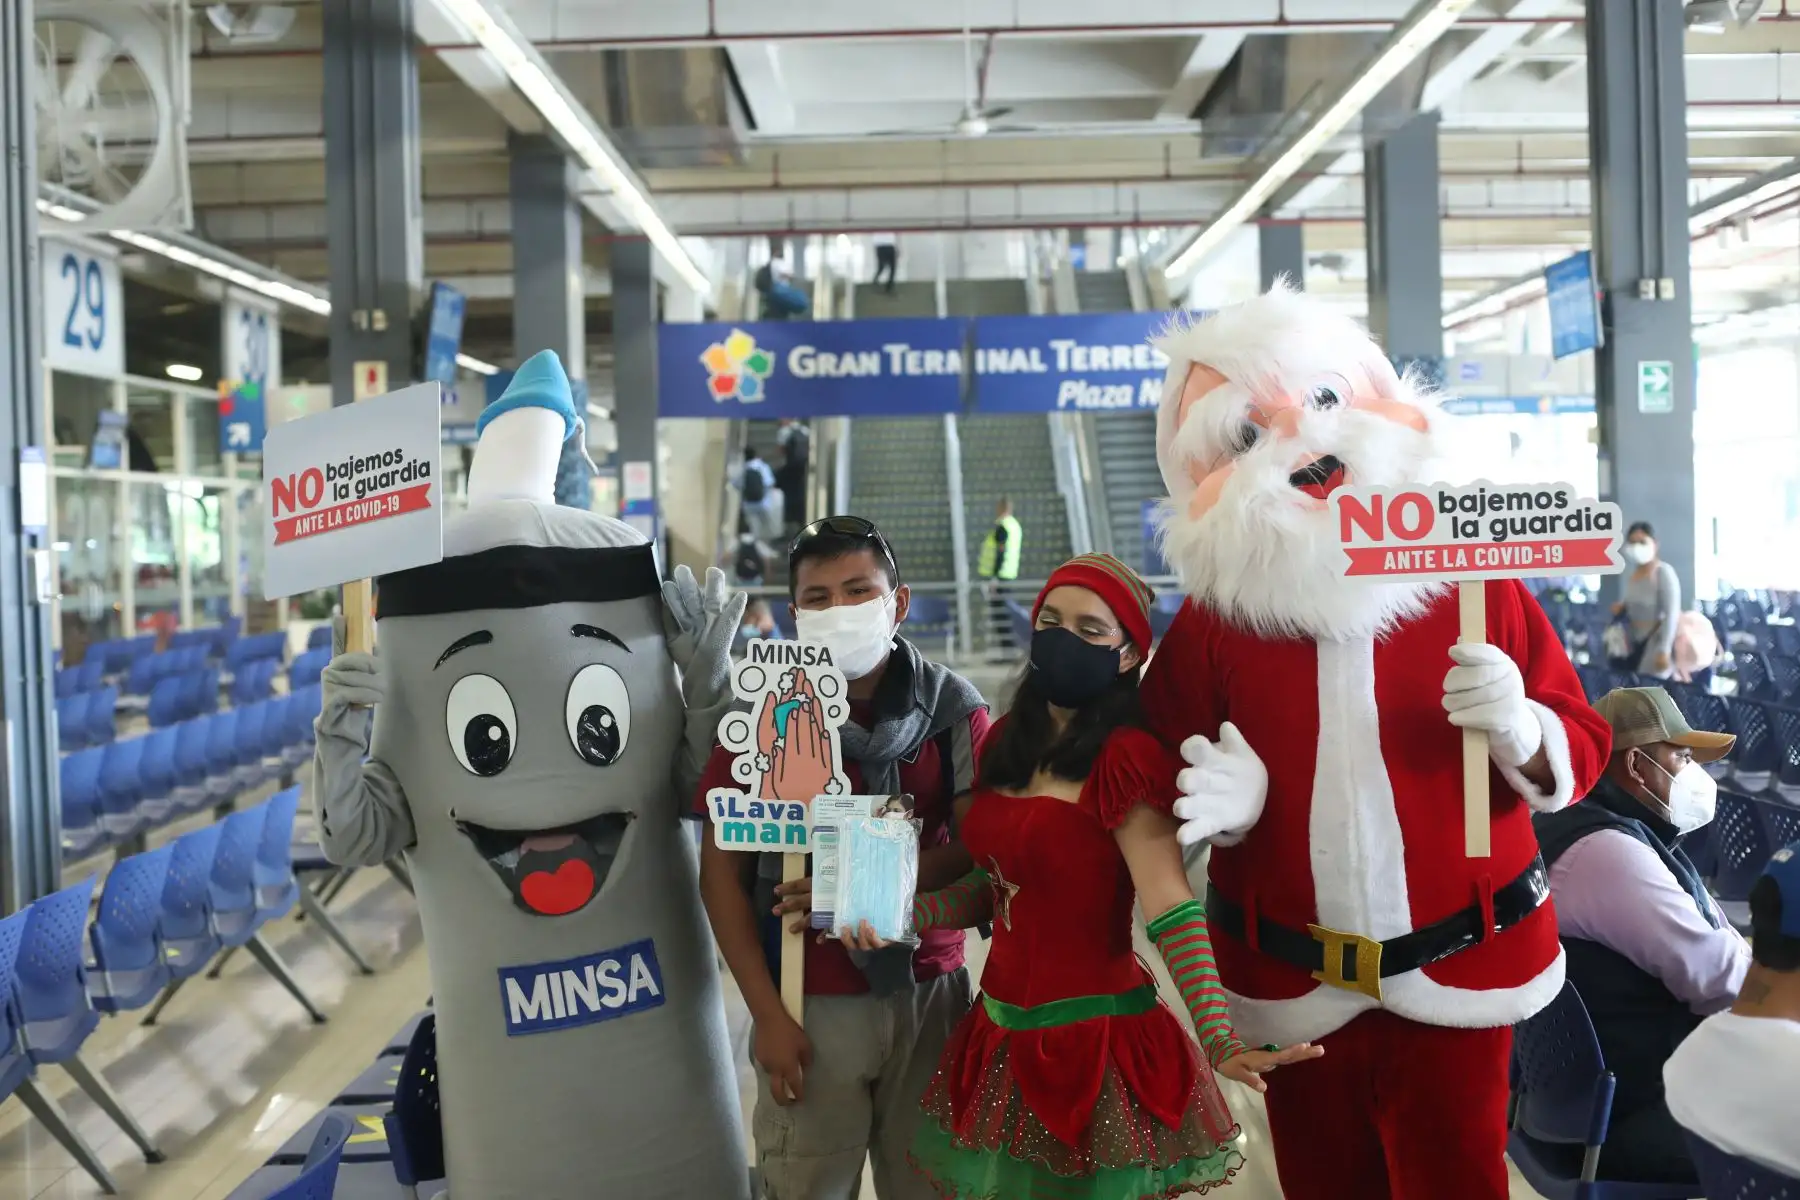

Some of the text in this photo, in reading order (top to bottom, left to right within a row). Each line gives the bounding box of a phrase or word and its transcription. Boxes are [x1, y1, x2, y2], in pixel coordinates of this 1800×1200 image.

[62, 254, 106, 351] 29
[788, 345, 881, 378] GRAN
[1048, 339, 1171, 372] TERRES
[1057, 379, 1134, 409] Plaza
[326, 448, 403, 482] bajemos
[333, 459, 430, 501] la guardia
[271, 467, 324, 518] NO
[1438, 488, 1568, 517] bajemos
[295, 495, 400, 536] ANTE LA COVID-19
[1337, 491, 1435, 542] NO
[1452, 507, 1612, 542] la guardia
[1384, 544, 1564, 570] ANTE LA COVID-19
[752, 643, 834, 666] MINSA
[722, 822, 807, 845] man
[505, 953, 660, 1024] MINSA
